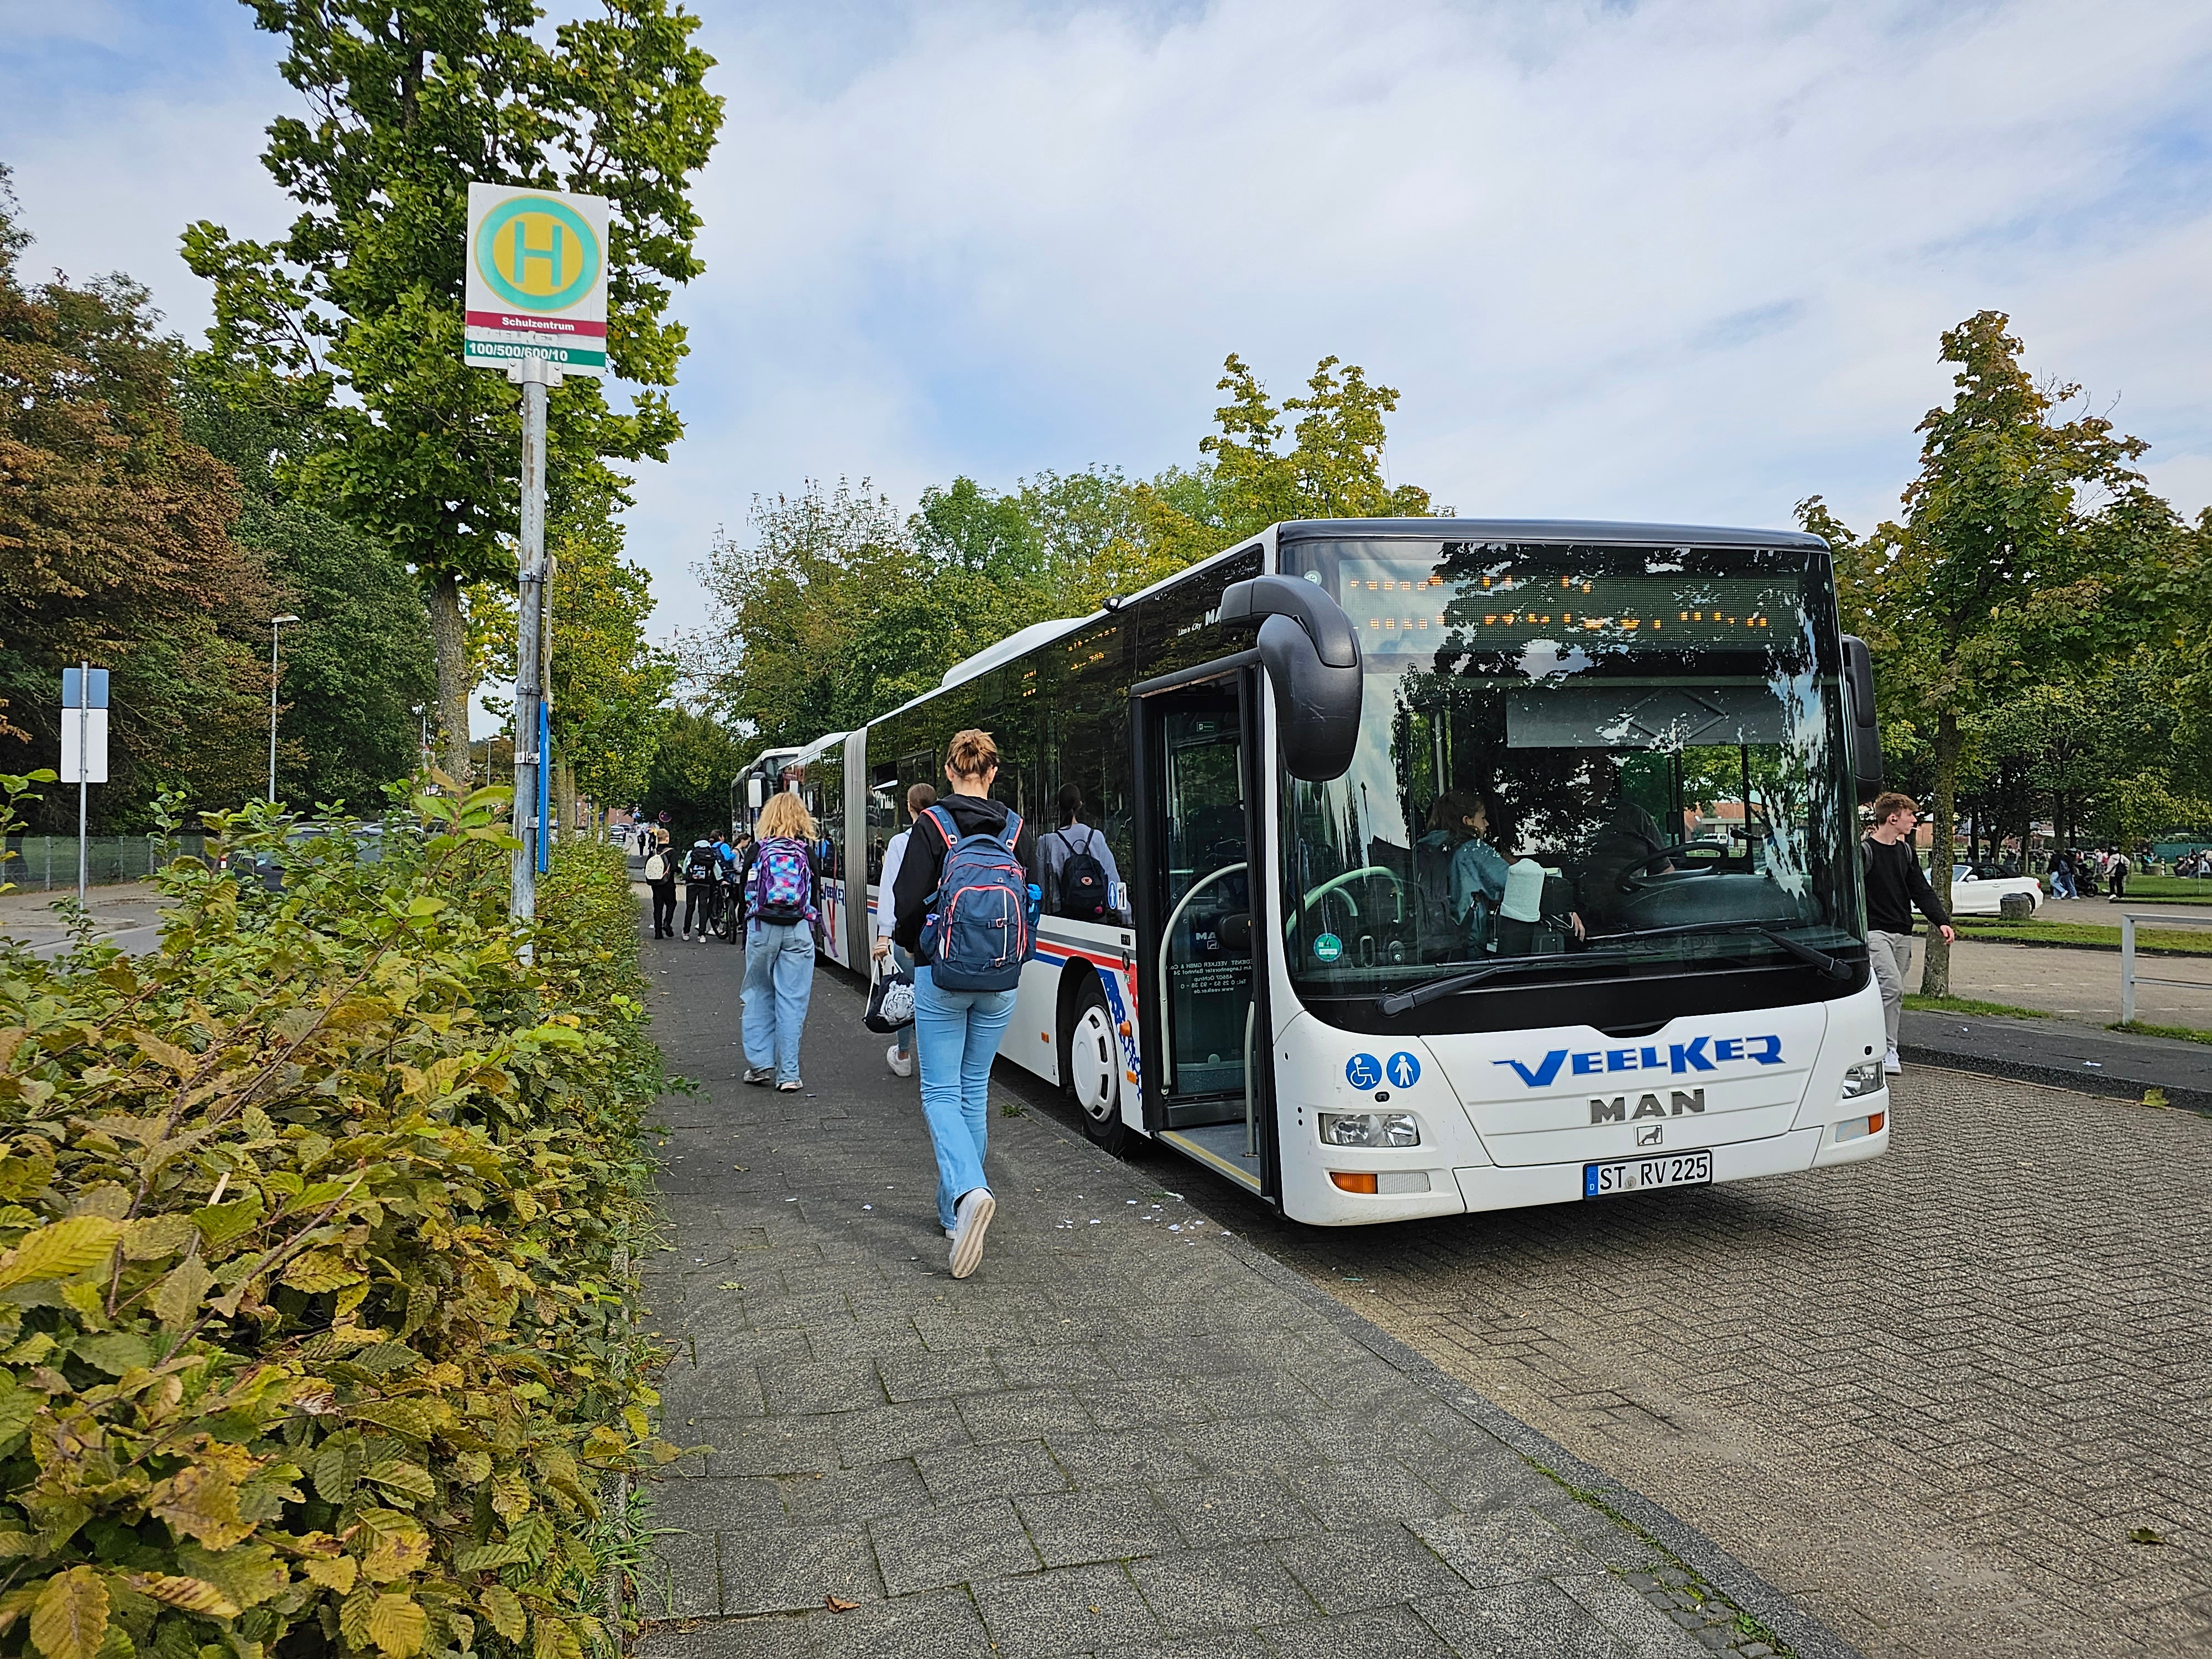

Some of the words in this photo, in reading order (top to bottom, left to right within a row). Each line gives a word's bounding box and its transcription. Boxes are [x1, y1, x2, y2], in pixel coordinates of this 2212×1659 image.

[513, 221, 562, 287] H
[502, 317, 575, 331] Schulzentrum
[469, 342, 568, 362] 100/500/600/10
[1191, 623, 1202, 631] City
[1205, 606, 1221, 627] MA
[1196, 932, 1216, 940] MA
[1324, 937, 1331, 948] 4
[1488, 1034, 1787, 1089] VEELKER
[1589, 1088, 1705, 1125] MAN
[1600, 1166, 1626, 1190] ST
[1641, 1161, 1666, 1186] RV
[1672, 1156, 1708, 1182] 225
